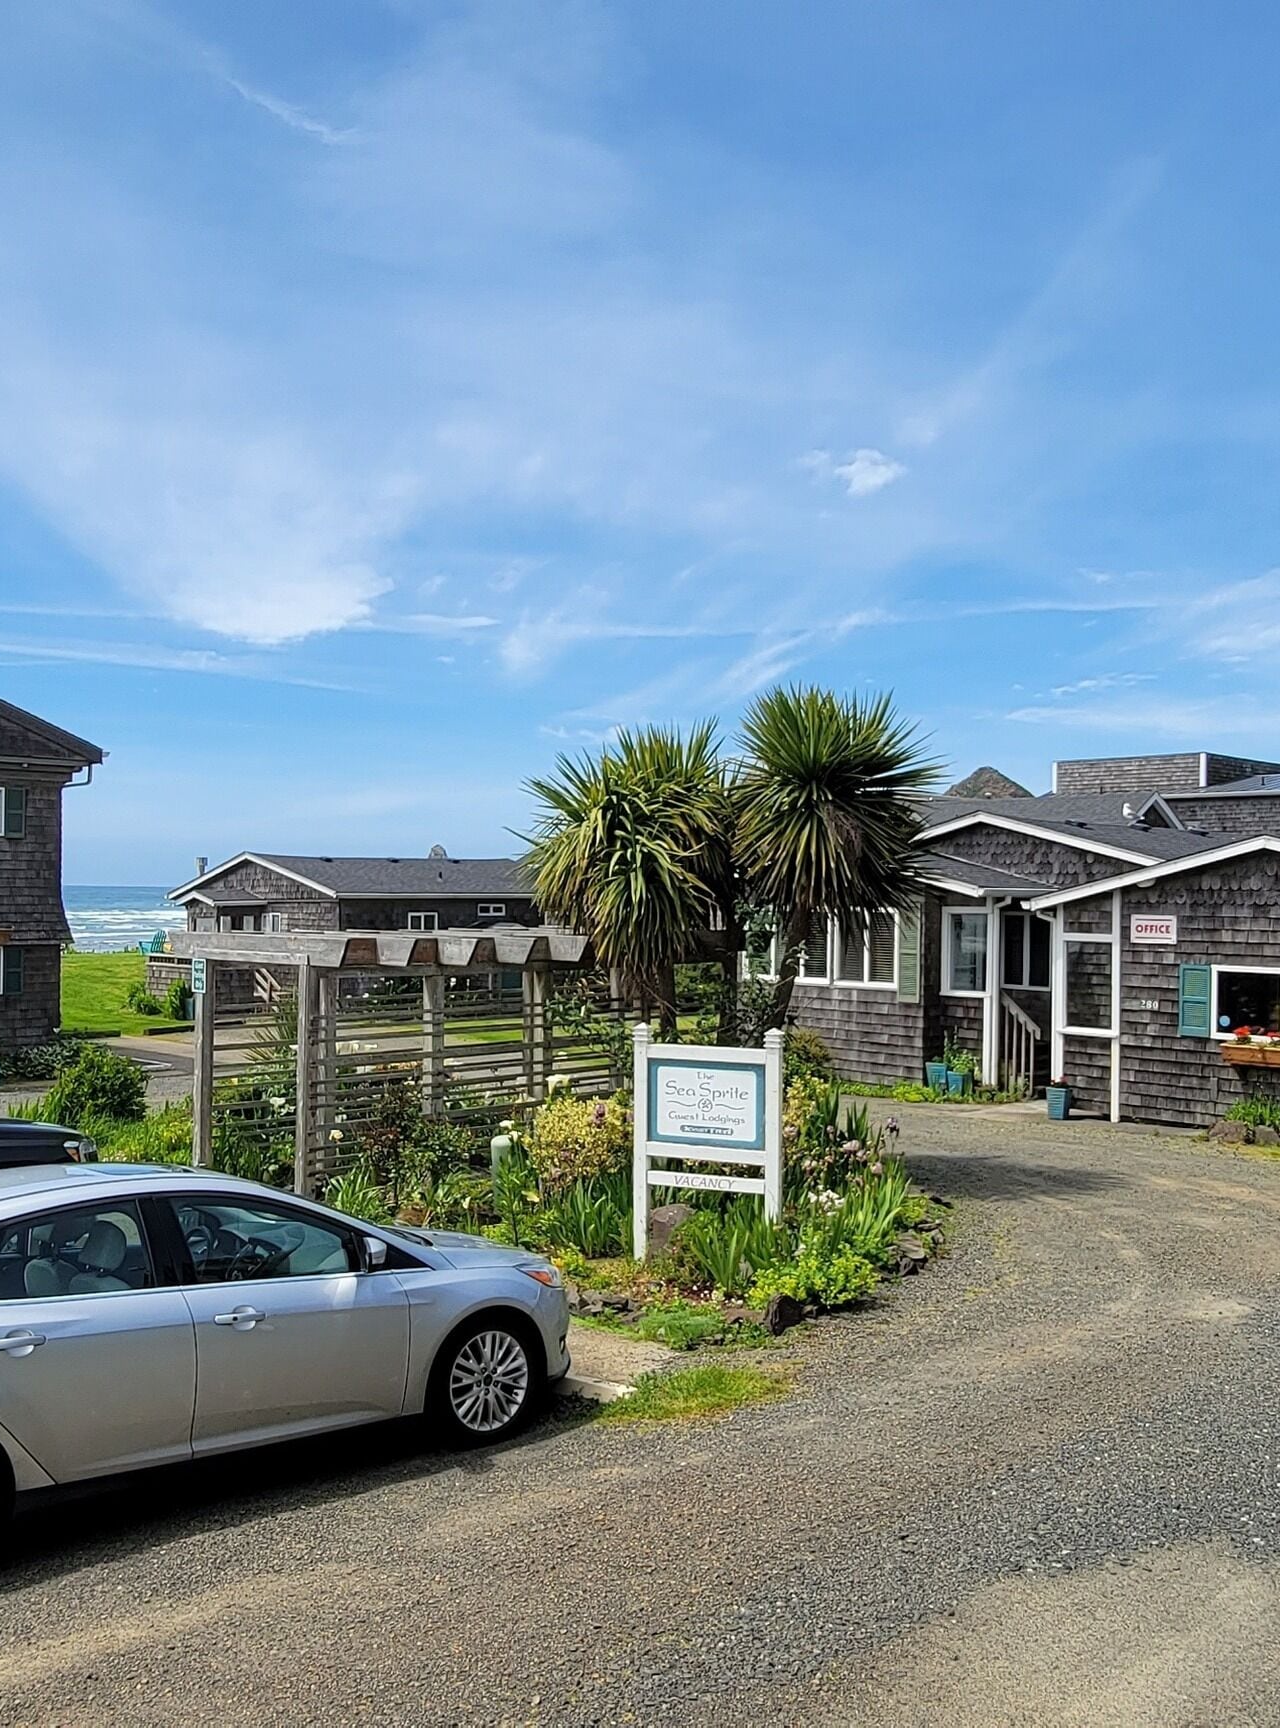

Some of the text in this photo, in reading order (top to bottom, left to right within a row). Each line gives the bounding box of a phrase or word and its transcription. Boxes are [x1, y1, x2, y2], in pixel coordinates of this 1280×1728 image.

[1135, 924, 1171, 934] OFFICE
[1140, 1000, 1159, 1009] 280
[665, 1080, 749, 1101] Sea Sprite
[668, 1110, 746, 1125] Guest Lodgings
[674, 1175, 736, 1190] VACANCY
